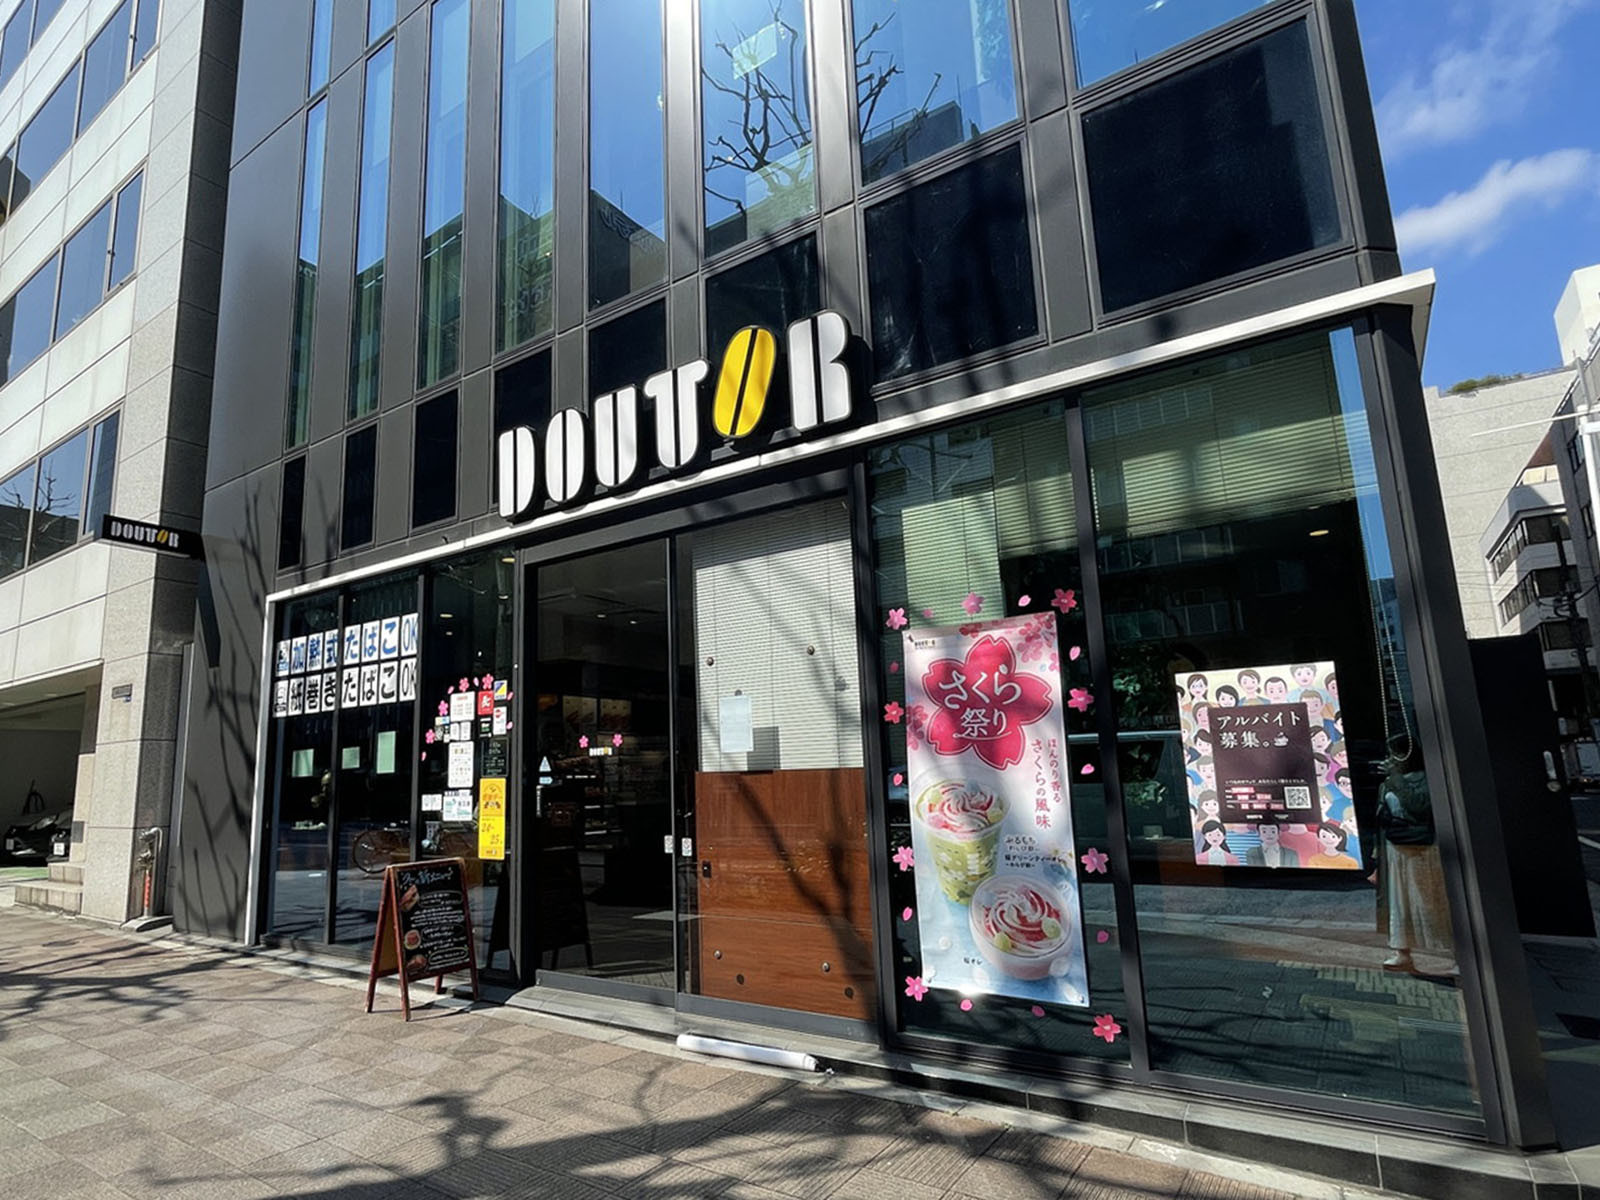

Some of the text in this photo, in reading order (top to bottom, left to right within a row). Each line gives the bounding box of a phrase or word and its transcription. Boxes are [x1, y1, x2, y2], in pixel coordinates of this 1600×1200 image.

[499, 309, 852, 517] DOUTOR
[111, 521, 179, 548] DOUTOR
[938, 664, 1022, 709] さくら
[960, 708, 1008, 738] 祭り
[1217, 711, 1301, 730] アルバイト
[1219, 731, 1270, 749] 募集。
[1031, 739, 1052, 829] さくらの風味
[1048, 739, 1062, 804] ほんのり香る
